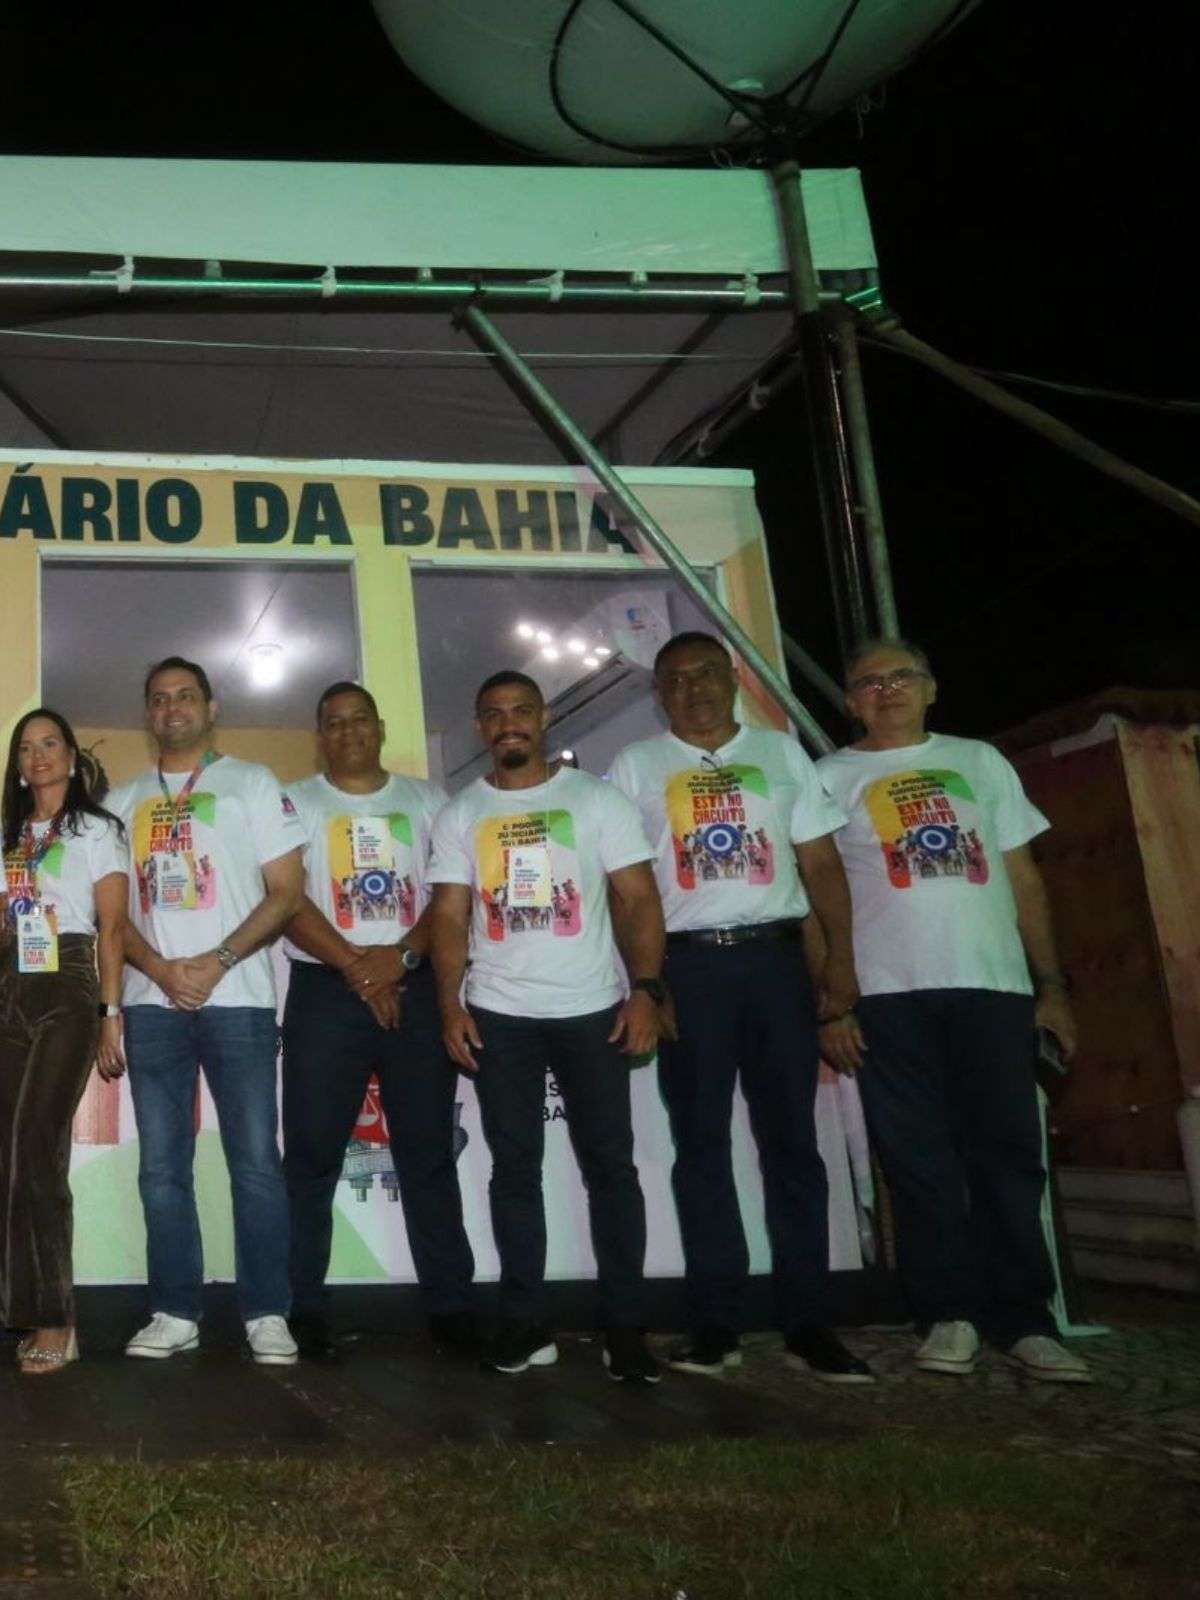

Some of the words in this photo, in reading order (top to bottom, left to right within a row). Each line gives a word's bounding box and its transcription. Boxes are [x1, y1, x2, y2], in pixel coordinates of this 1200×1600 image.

[233, 481, 353, 545] DA
[379, 483, 645, 554] BAHIA
[727, 792, 743, 806] NO
[932, 796, 950, 811] NO
[693, 807, 746, 825] CIRCUITO
[900, 810, 957, 828] CIRCUITO
